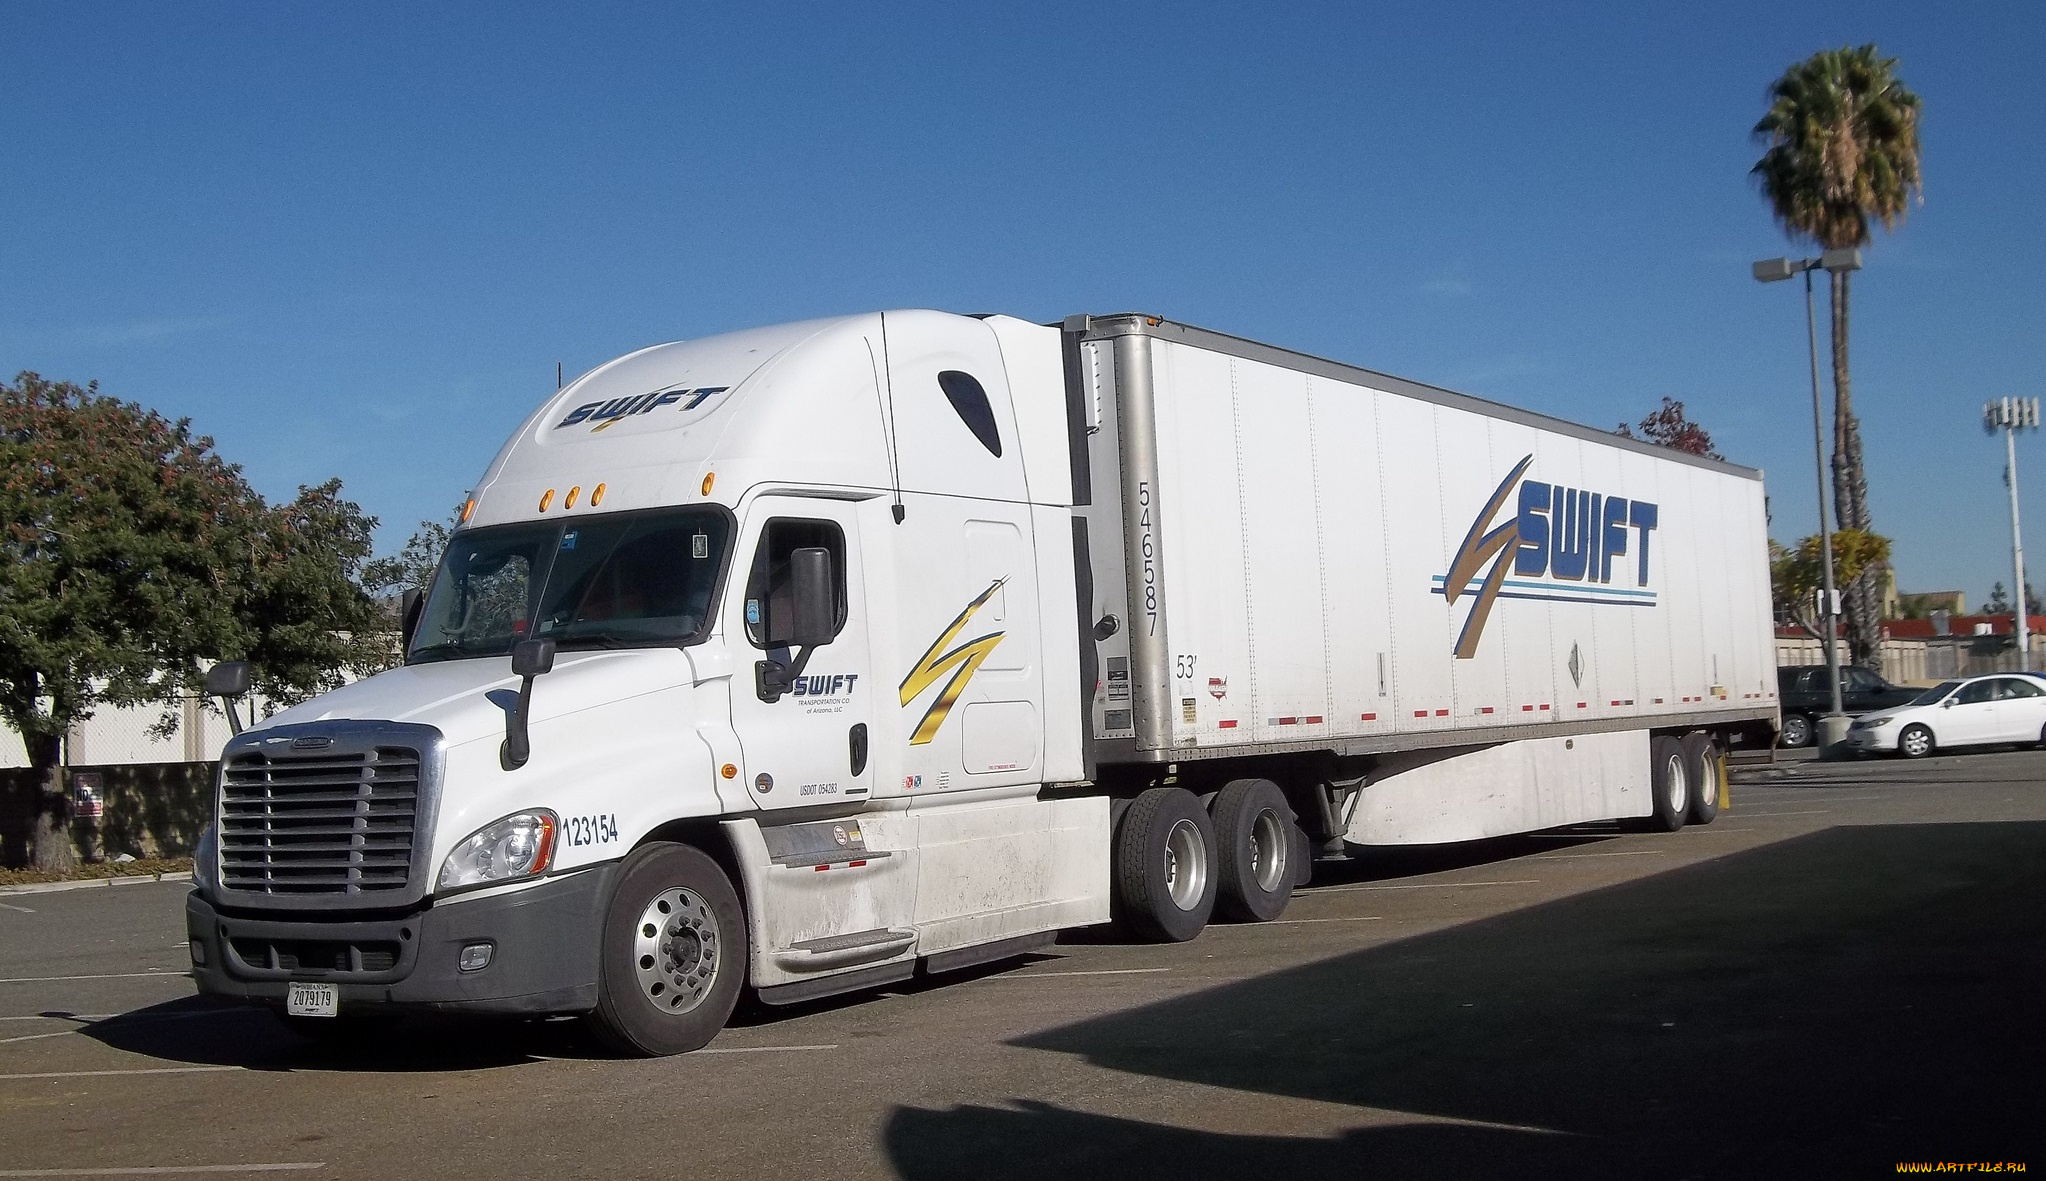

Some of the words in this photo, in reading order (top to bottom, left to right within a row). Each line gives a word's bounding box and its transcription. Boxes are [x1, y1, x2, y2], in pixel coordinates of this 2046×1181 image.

[552, 386, 730, 430] SWIFT
[1514, 479, 1658, 587] SWIFT
[1139, 482, 1157, 636] 546587
[793, 674, 858, 697] SWIFT
[800, 784, 817, 796] USDOT
[818, 782, 838, 795] 054283
[563, 813, 618, 847] 123154
[293, 990, 331, 1006] 2079179
